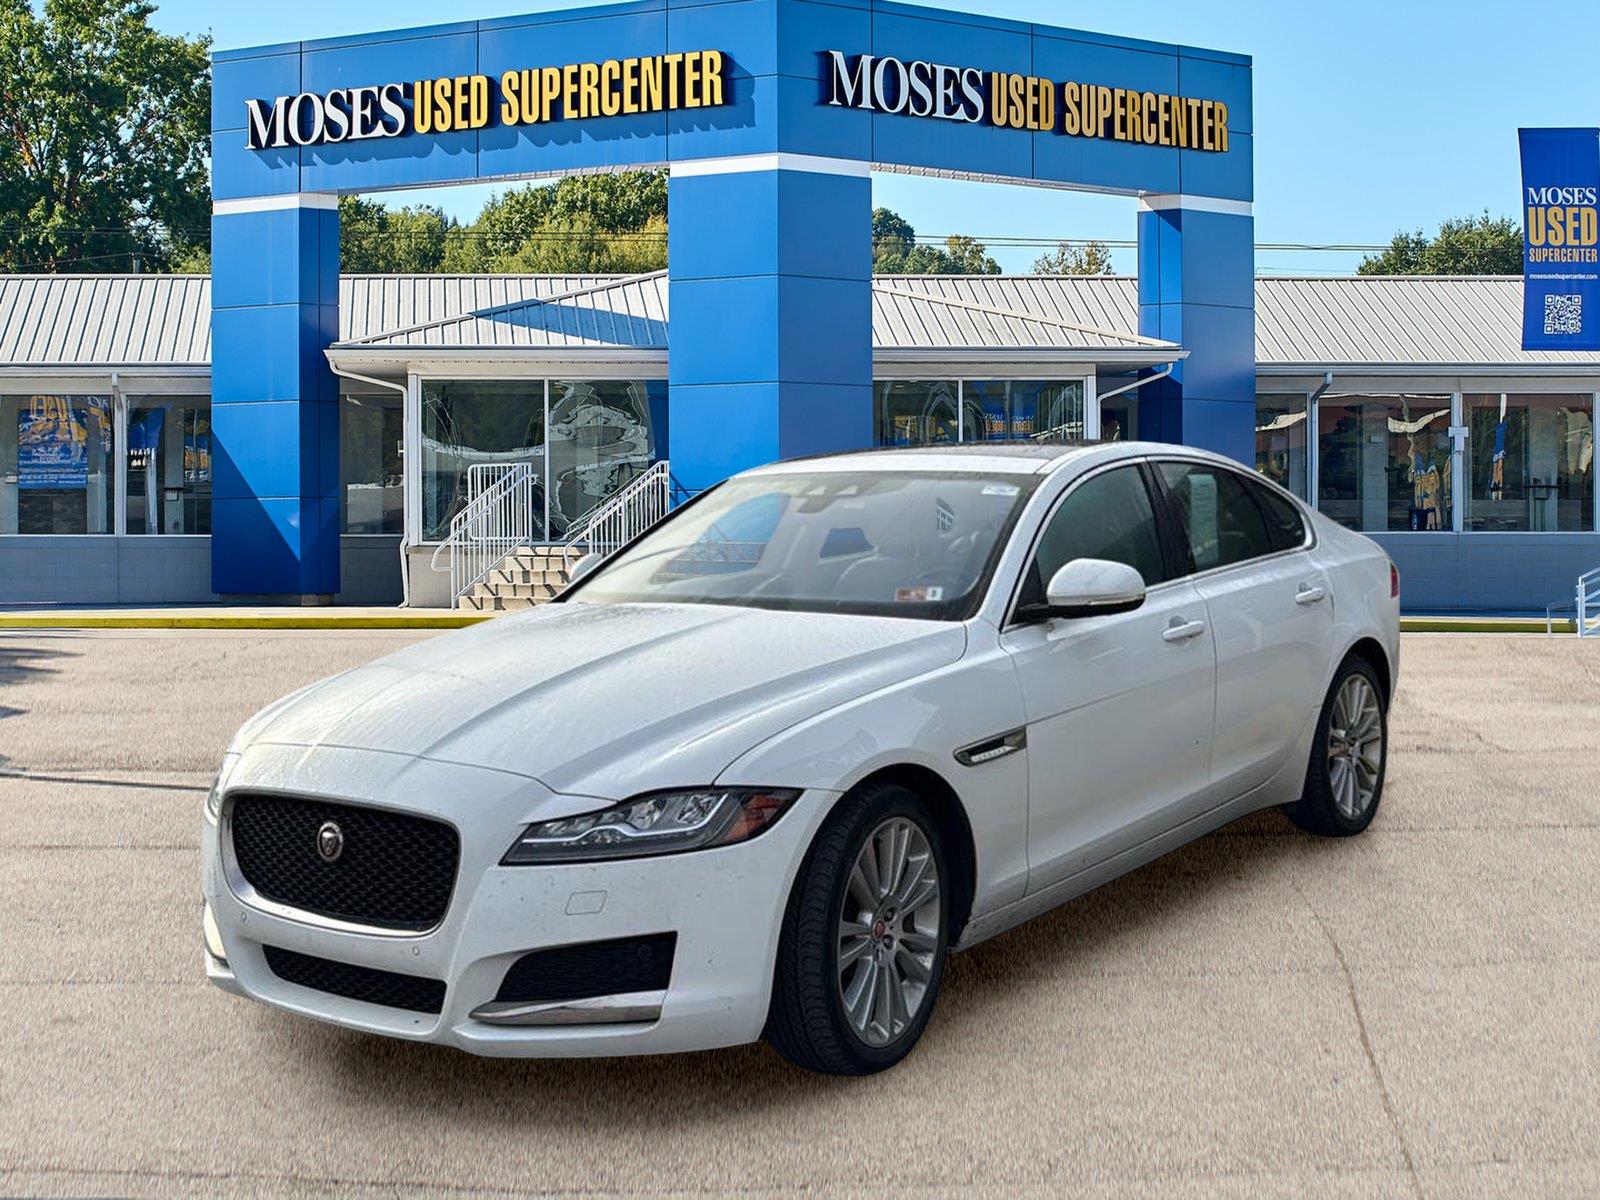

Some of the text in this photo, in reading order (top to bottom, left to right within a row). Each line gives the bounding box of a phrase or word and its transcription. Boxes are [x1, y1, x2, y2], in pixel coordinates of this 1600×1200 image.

[245, 49, 725, 151] MOSES USED SUPERCENTER
[828, 49, 1230, 153] MOSES USED SUPERCENTER
[1527, 187, 1597, 206] MOSES
[1528, 206, 1598, 247] USED
[1529, 247, 1598, 263] SUPERCENTER
